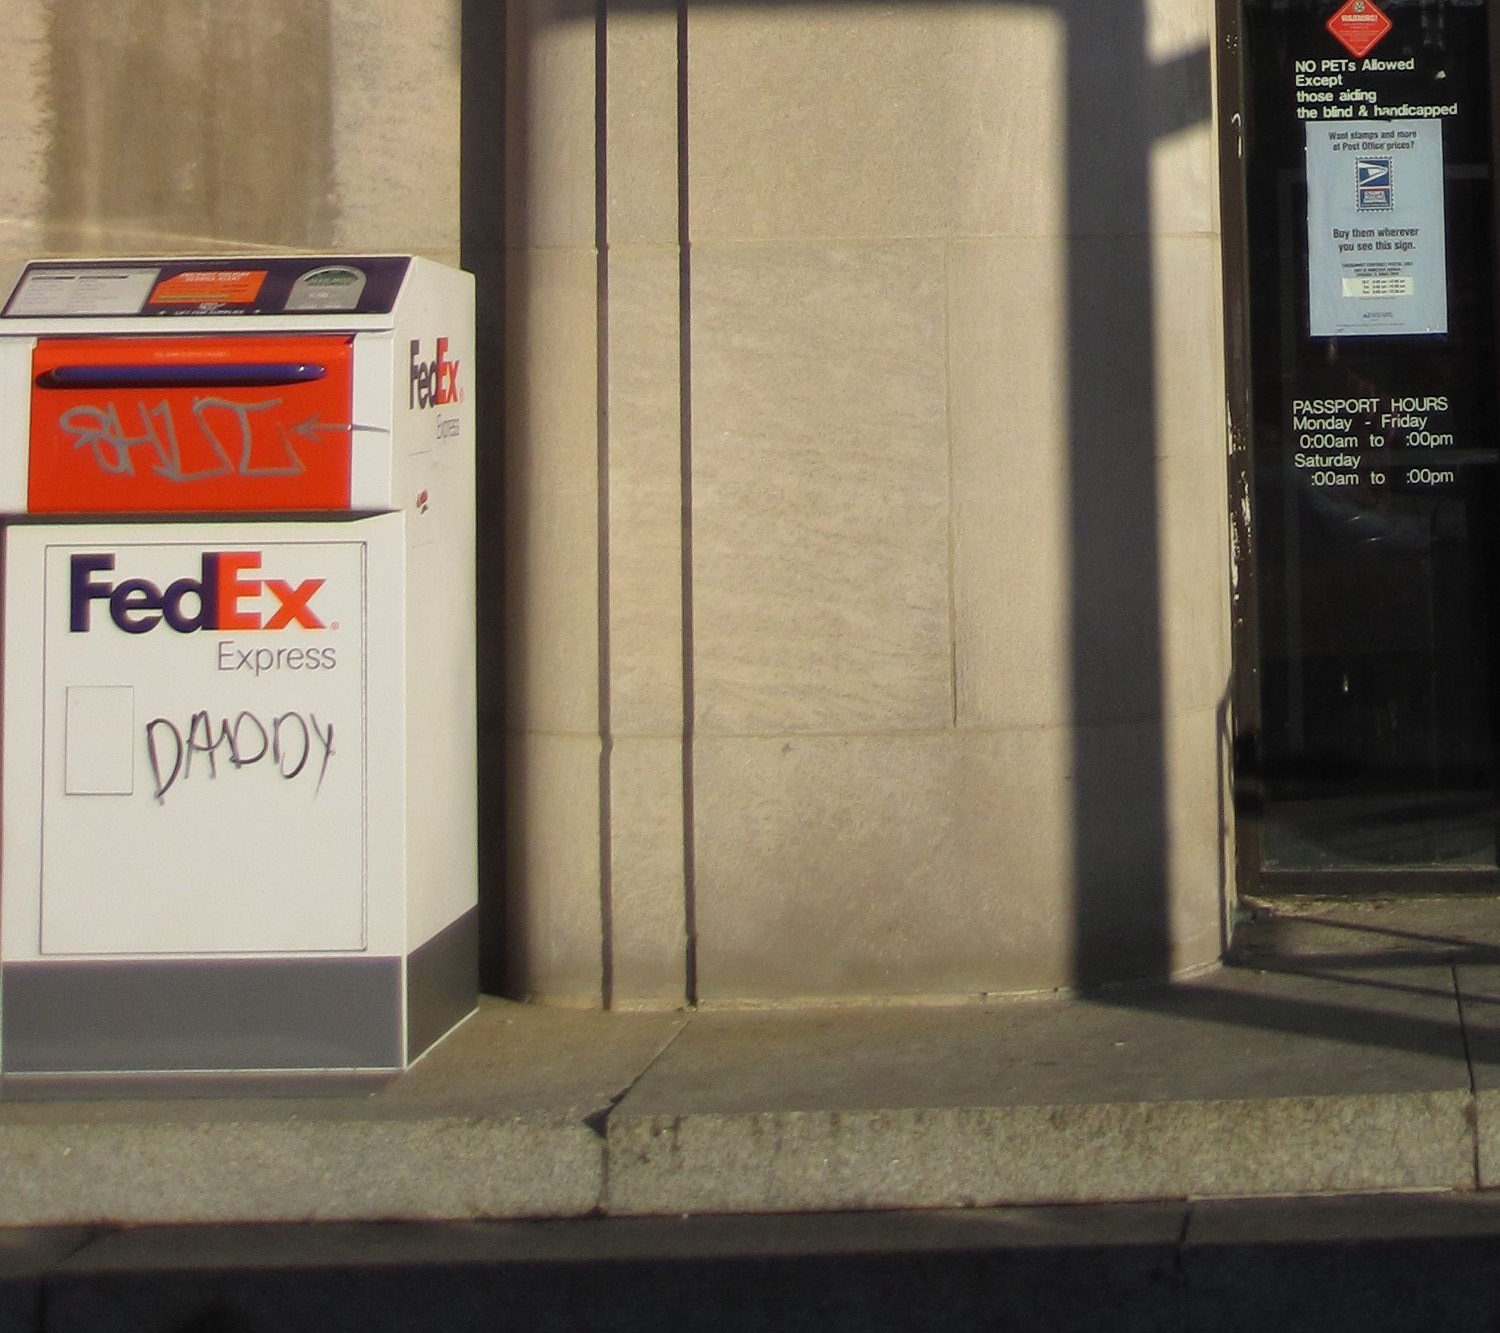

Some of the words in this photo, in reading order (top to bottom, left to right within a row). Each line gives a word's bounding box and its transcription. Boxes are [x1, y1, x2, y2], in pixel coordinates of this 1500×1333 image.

[1295, 60, 1317, 73] NO
[1321, 59, 1356, 72] PETs
[1362, 58, 1415, 71] Allowed
[1295, 74, 1343, 88] Except
[1296, 90, 1334, 102] those
[1339, 89, 1377, 103] aiding
[1296, 106, 1318, 118] the
[1323, 105, 1353, 118] blind
[1358, 104, 1369, 116] &
[1374, 102, 1458, 117] handicapped
[1329, 131, 1349, 140] Want
[1350, 132, 1378, 140] stamps
[1381, 130, 1395, 139] and
[1397, 130, 1417, 138] more
[1333, 143, 1341, 151] at
[1342, 142, 1360, 151] Post
[1386, 140, 1415, 151] prices?
[1333, 228, 1349, 239] Buy
[1352, 228, 1374, 238] them
[1377, 227, 1419, 237] wherever
[1338, 242, 1354, 253] you
[1357, 242, 1373, 251] see
[1375, 241, 1392, 250] this
[1394, 240, 1417, 252] sign.
[409, 337, 461, 410] FedEx
[1292, 398, 1380, 414] PASSPORT
[1390, 396, 1448, 412] HOURS
[1293, 415, 1352, 432] Monday
[1381, 414, 1428, 429] Friday
[1369, 433, 1385, 448] to
[1294, 452, 1361, 469] Saturday
[1370, 471, 1386, 485] to
[68, 551, 328, 634] FedEx
[218, 640, 338, 676] Express
[146, 709, 337, 806] DADDY
